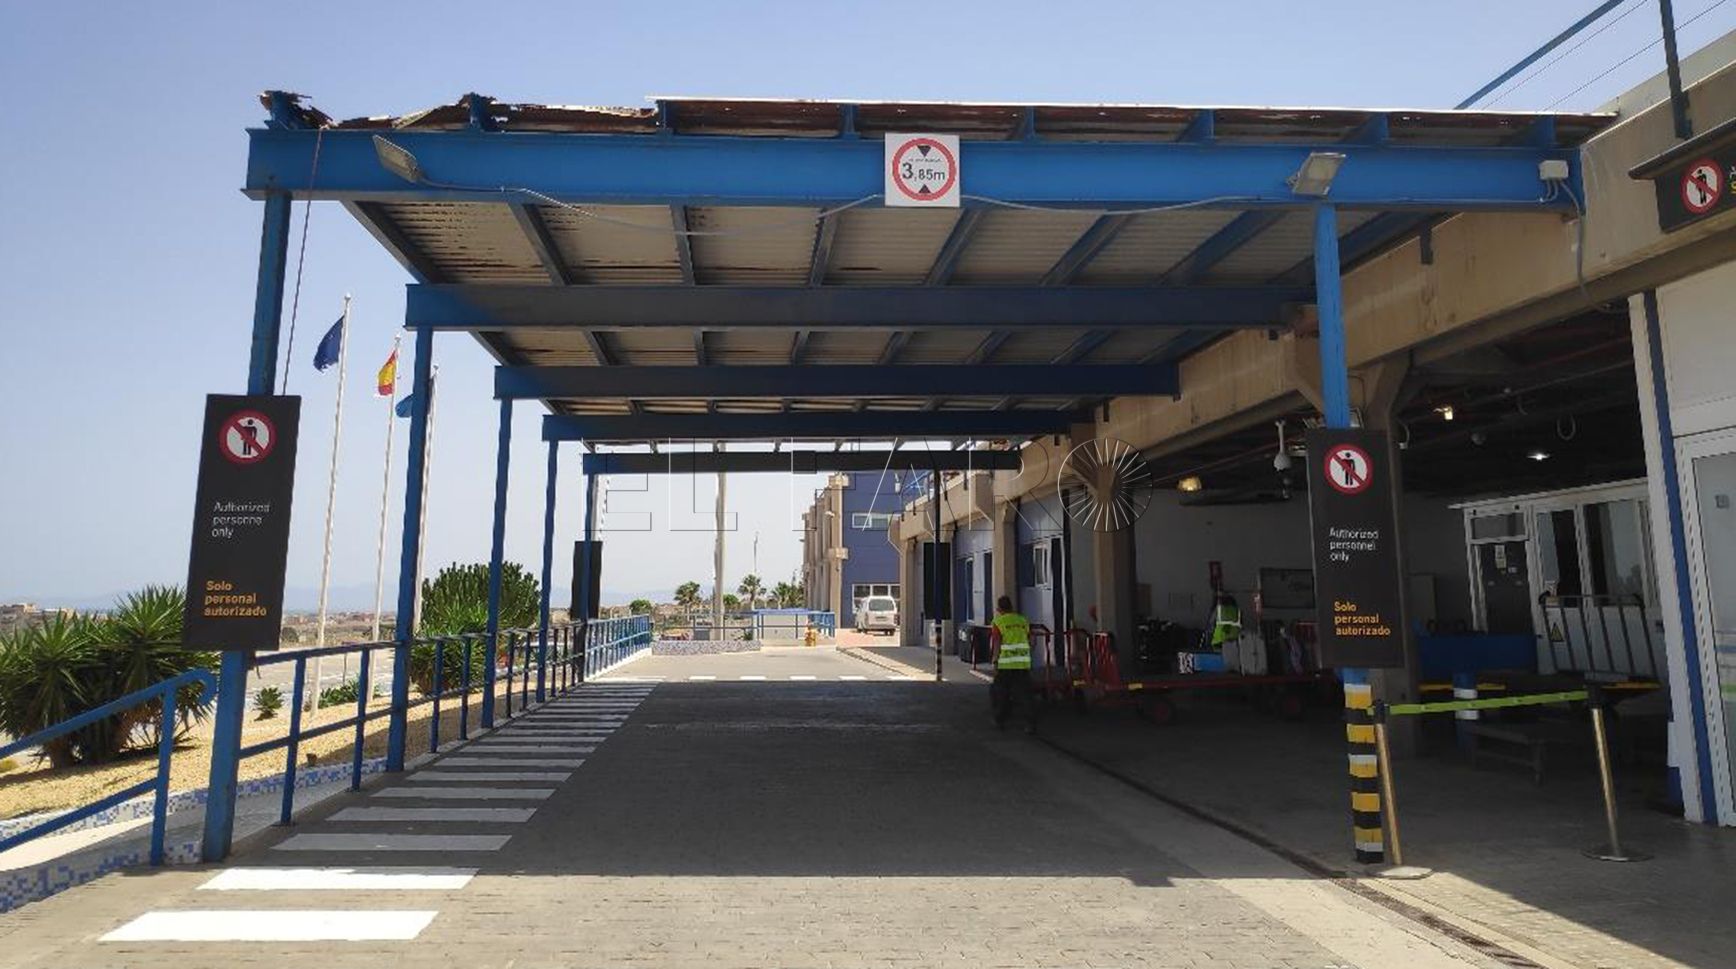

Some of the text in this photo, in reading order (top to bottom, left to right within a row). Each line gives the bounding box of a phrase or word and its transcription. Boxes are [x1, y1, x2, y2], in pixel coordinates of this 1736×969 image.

[213, 501, 271, 513] Authorized
[211, 516, 265, 528] personne
[211, 526, 234, 539] only
[1329, 527, 1379, 540] Authorized
[1330, 540, 1376, 551] personnel
[1330, 550, 1350, 562] only
[206, 580, 233, 591] Solo
[204, 593, 257, 606] personal
[204, 605, 267, 617] autorizado
[1333, 601, 1357, 612] Solo
[1334, 613, 1379, 625] personal
[1335, 625, 1391, 636] autorizado
